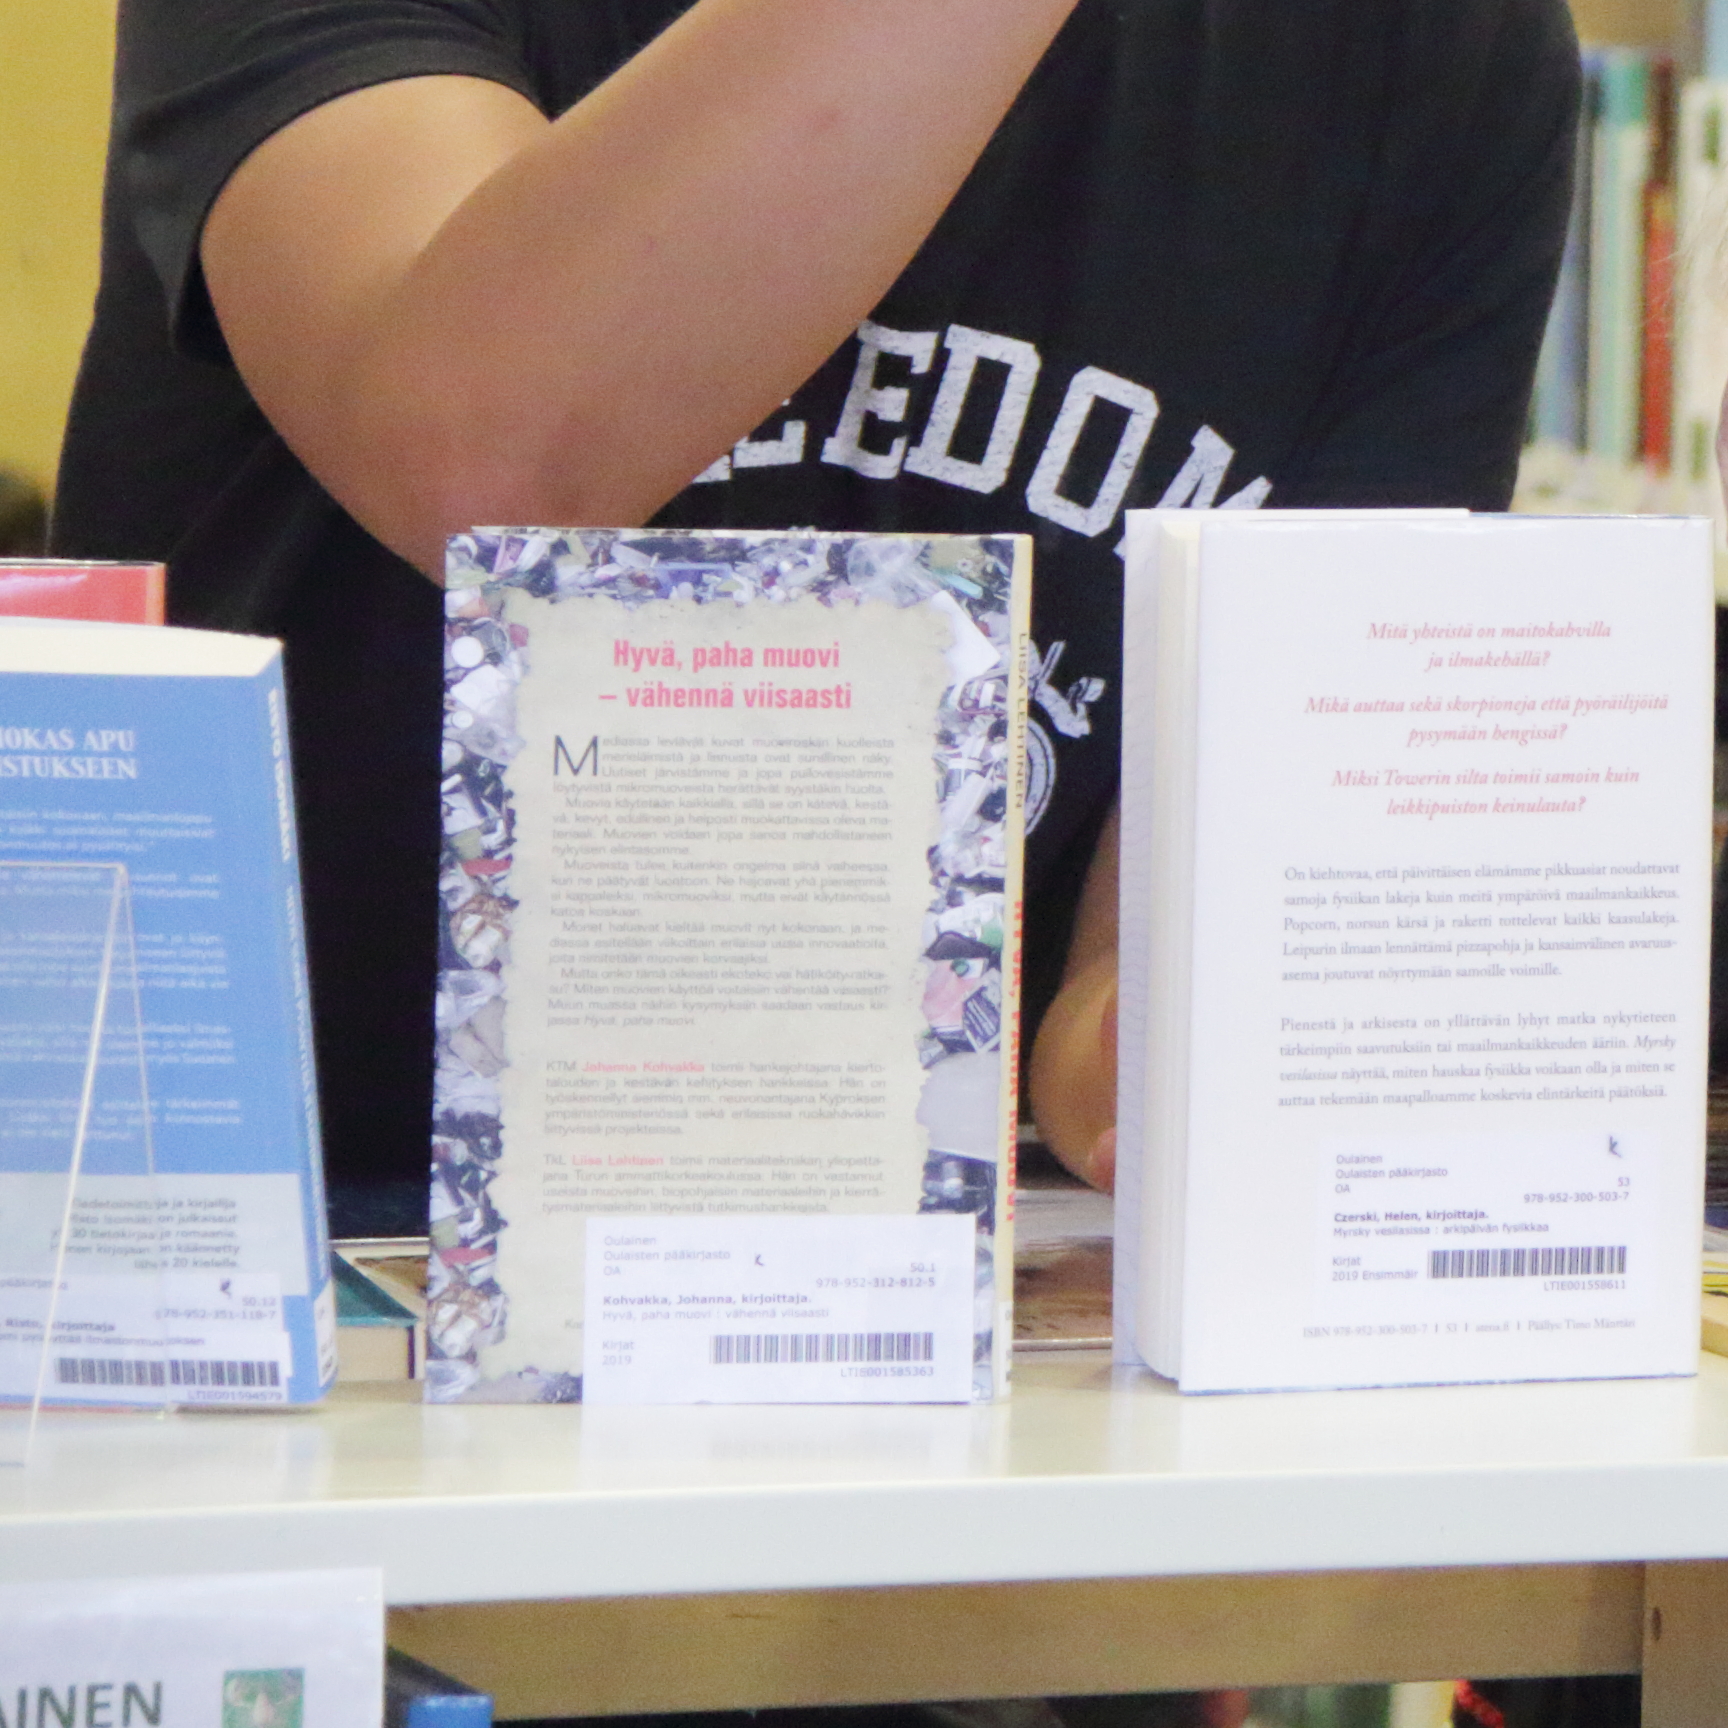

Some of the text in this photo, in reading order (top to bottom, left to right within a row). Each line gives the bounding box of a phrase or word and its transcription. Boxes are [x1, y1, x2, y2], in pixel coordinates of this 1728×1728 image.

[1367, 620, 1611, 640] Mitä yhteistä on maitokahvilla
[612, 639, 840, 673] Hyvä, paha muovi
[1426, 650, 1551, 669] ja ilmakehällä?
[625, 681, 734, 708] vähennä
[742, 681, 852, 709] viisaasti
[1305, 693, 1668, 717] Mikä auttaa sekä skorpioneja että pyöräilijöitä
[1014, 633, 1030, 809] LIISA LEHTINEN
[82, 729, 136, 752] APU
[1407, 722, 1568, 748] pysymään hengissä?
[1332, 766, 1640, 786] Miksi Towerin silta toimii samoin kuin
[1385, 795, 1587, 820] leikkipuiston keinulauta?
[1283, 866, 1306, 880] On
[1374, 867, 1398, 879] että
[1474, 863, 1541, 877] elämämme
[1283, 893, 1327, 908] samoja
[1332, 890, 1380, 908] fysiikan
[1385, 890, 1421, 907] lakeja
[1425, 890, 1453, 903] kuin
[1458, 890, 1493, 902] meitä
[1283, 916, 1340, 934] Popcorn,
[1345, 919, 1390, 929] norsun
[1395, 915, 1428, 929] kärsä
[1434, 918, 1446, 930] ja
[1451, 914, 1492, 928] raketti
[1563, 911, 1601, 925] kaikki
[1282, 941, 1337, 960] Leipurin
[1340, 941, 1382, 955] ilmaan
[1523, 939, 1535, 953] ja
[1628, 939, 1673, 949] avaruus-
[1281, 971, 1320, 981] asema
[1323, 969, 1374, 981] joutuvat
[1455, 963, 1506, 977] samoille
[1280, 1016, 1336, 1031] Pienestä
[1342, 1020, 1354, 1031] ja
[1423, 1018, 1441, 1027] on
[1516, 1011, 1550, 1029] lyhyt
[1556, 1011, 1596, 1025] matka
[581, 1060, 706, 1072] Johanna Kohvakka
[1277, 1095, 1315, 1106] auttaa
[1319, 1091, 1379, 1105] tekemään
[1479, 1087, 1533, 1101] koskevia
[1335, 1153, 1383, 1164] Oulainen
[1335, 1166, 1448, 1179] Oulaisten pääkirjasto
[1333, 1183, 1351, 1193] OA
[1616, 1176, 1631, 1187] 53
[1522, 1190, 1630, 1203] 978-952-300-503-7
[1333, 1209, 1488, 1223] Czerski, Helen, kirjoittaja.
[1332, 1226, 1371, 1238] Myrsky
[1373, 1225, 1431, 1236] vesilasissa
[1442, 1223, 1499, 1235] arkipäivän
[1501, 1221, 1549, 1233] fysiikkaa
[603, 1234, 657, 1246] Oulainen
[603, 1249, 731, 1261] Oulaisten pääkirjasto
[1331, 1256, 1362, 1266] Kirjat
[602, 1265, 622, 1276] OA
[908, 1262, 936, 1273] 50.1
[815, 1276, 936, 1288] 978-952-312-812-5
[1331, 1269, 1359, 1281] 2019
[1542, 1278, 1626, 1291] LTIE001558611
[603, 1293, 811, 1306] Kohvakka, Johanna, kirjoittaja.
[602, 1310, 636, 1321] Hyvä,
[640, 1310, 671, 1321] paha
[674, 1309, 712, 1319] muovi
[724, 1307, 777, 1319] vähennä
[780, 1308, 829, 1318] viisaasti
[601, 1339, 635, 1351] Kirjat
[601, 1354, 633, 1366] 2019
